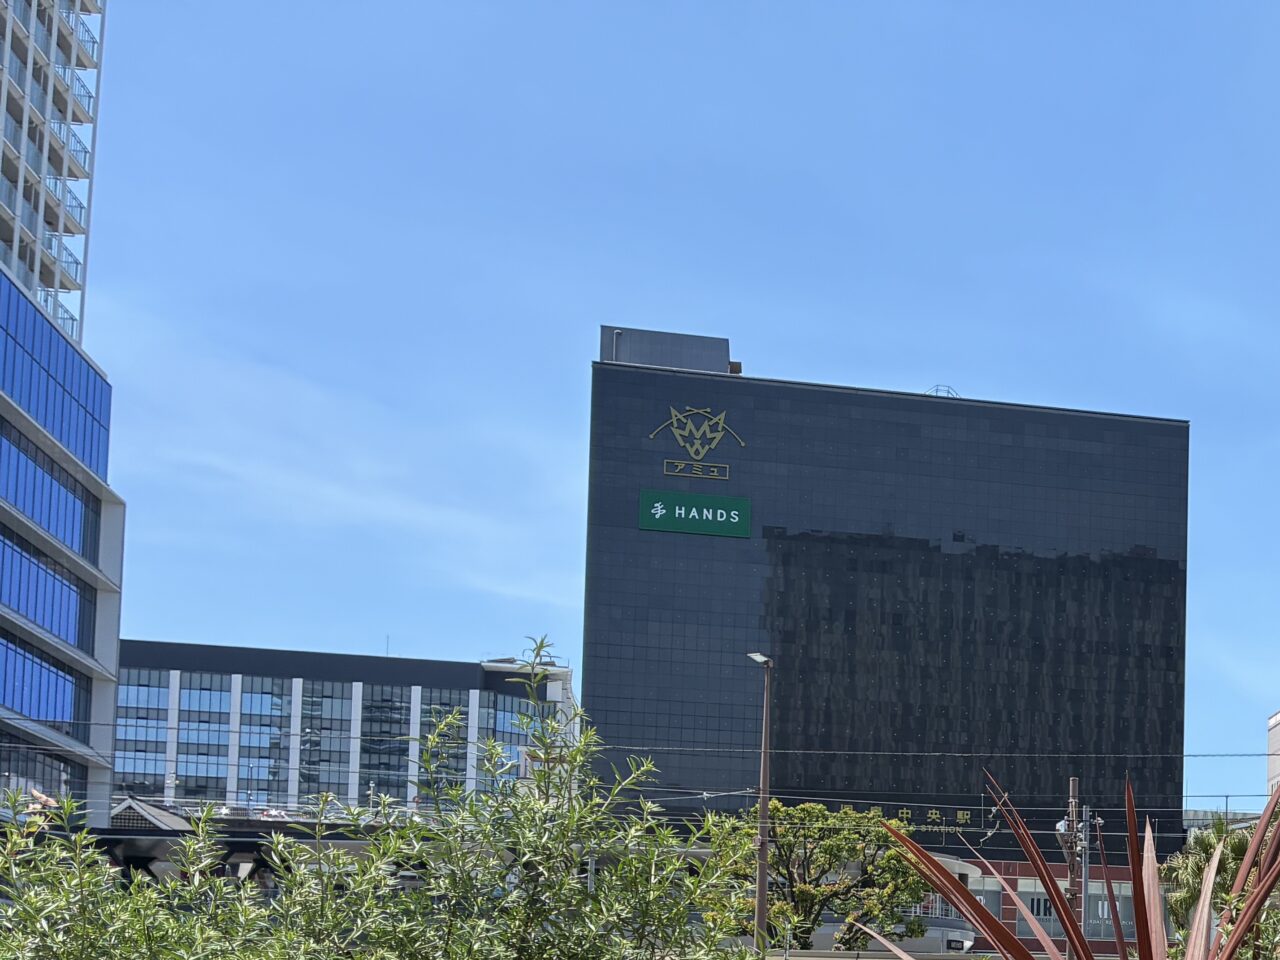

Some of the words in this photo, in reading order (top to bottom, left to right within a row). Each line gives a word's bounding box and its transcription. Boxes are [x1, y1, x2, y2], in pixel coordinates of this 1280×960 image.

[673, 462, 719, 476] アミュ
[675, 505, 740, 523] HANDS
